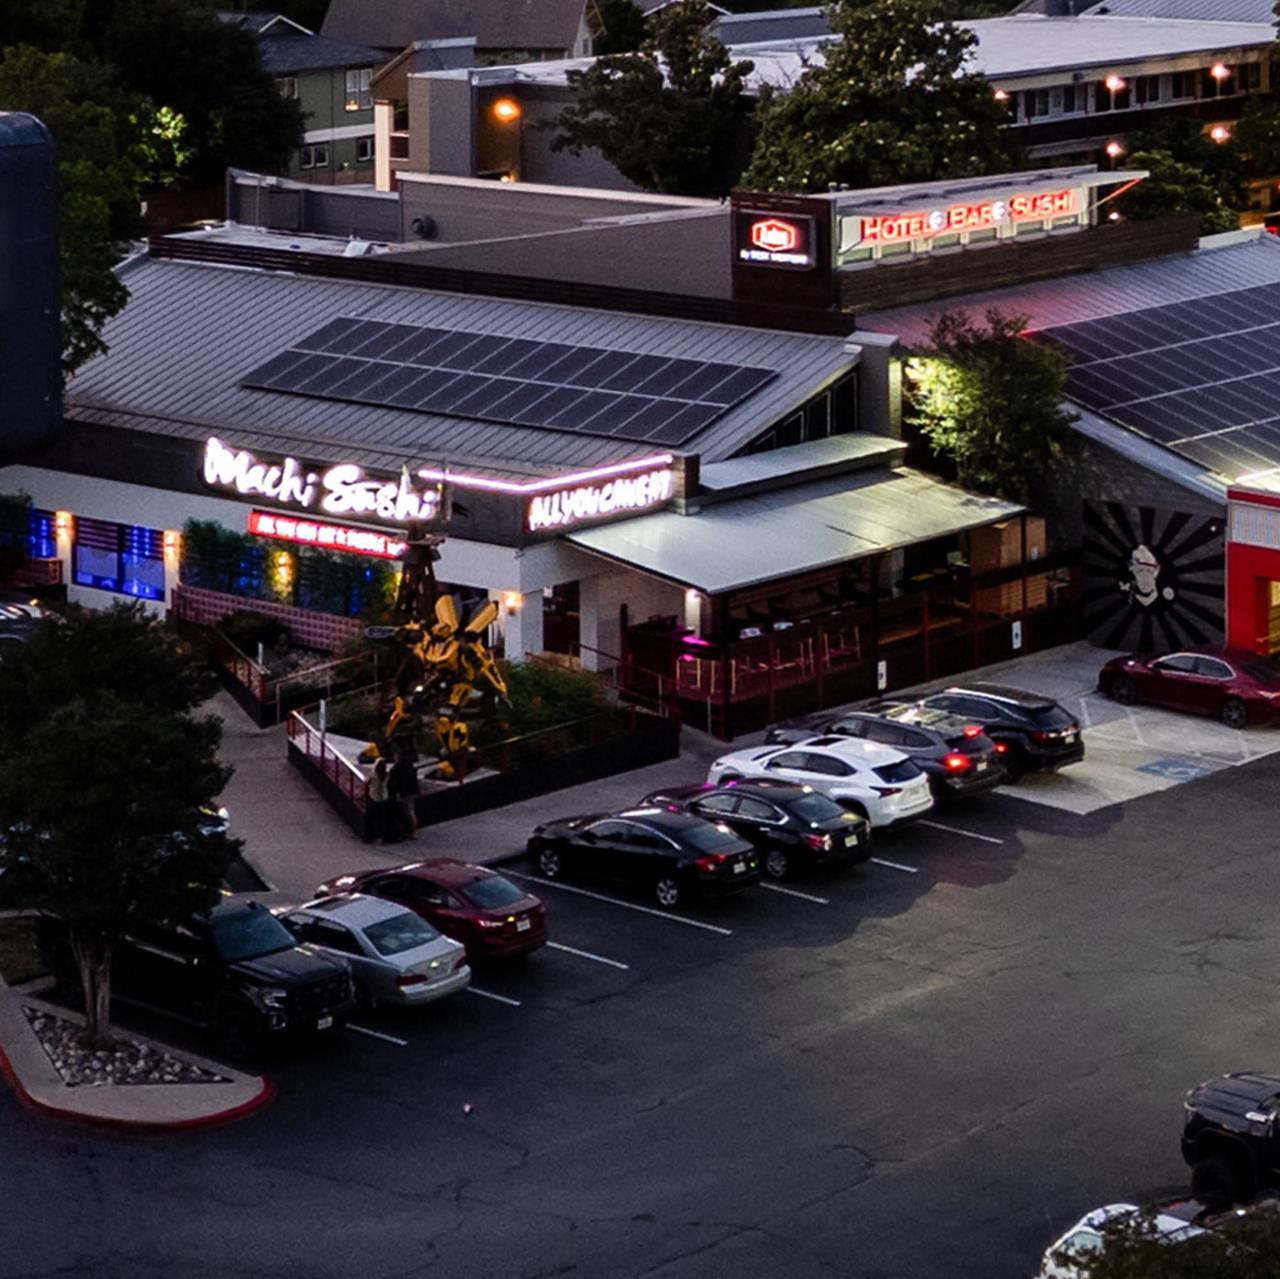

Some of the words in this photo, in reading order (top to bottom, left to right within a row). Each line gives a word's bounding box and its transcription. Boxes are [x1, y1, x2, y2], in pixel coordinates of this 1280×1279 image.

[865, 217, 931, 240] HOTEL
[950, 205, 993, 228] BAR
[1013, 191, 1076, 217] SUSHI
[204, 436, 318, 507] Machi
[529, 492, 562, 531] ALL
